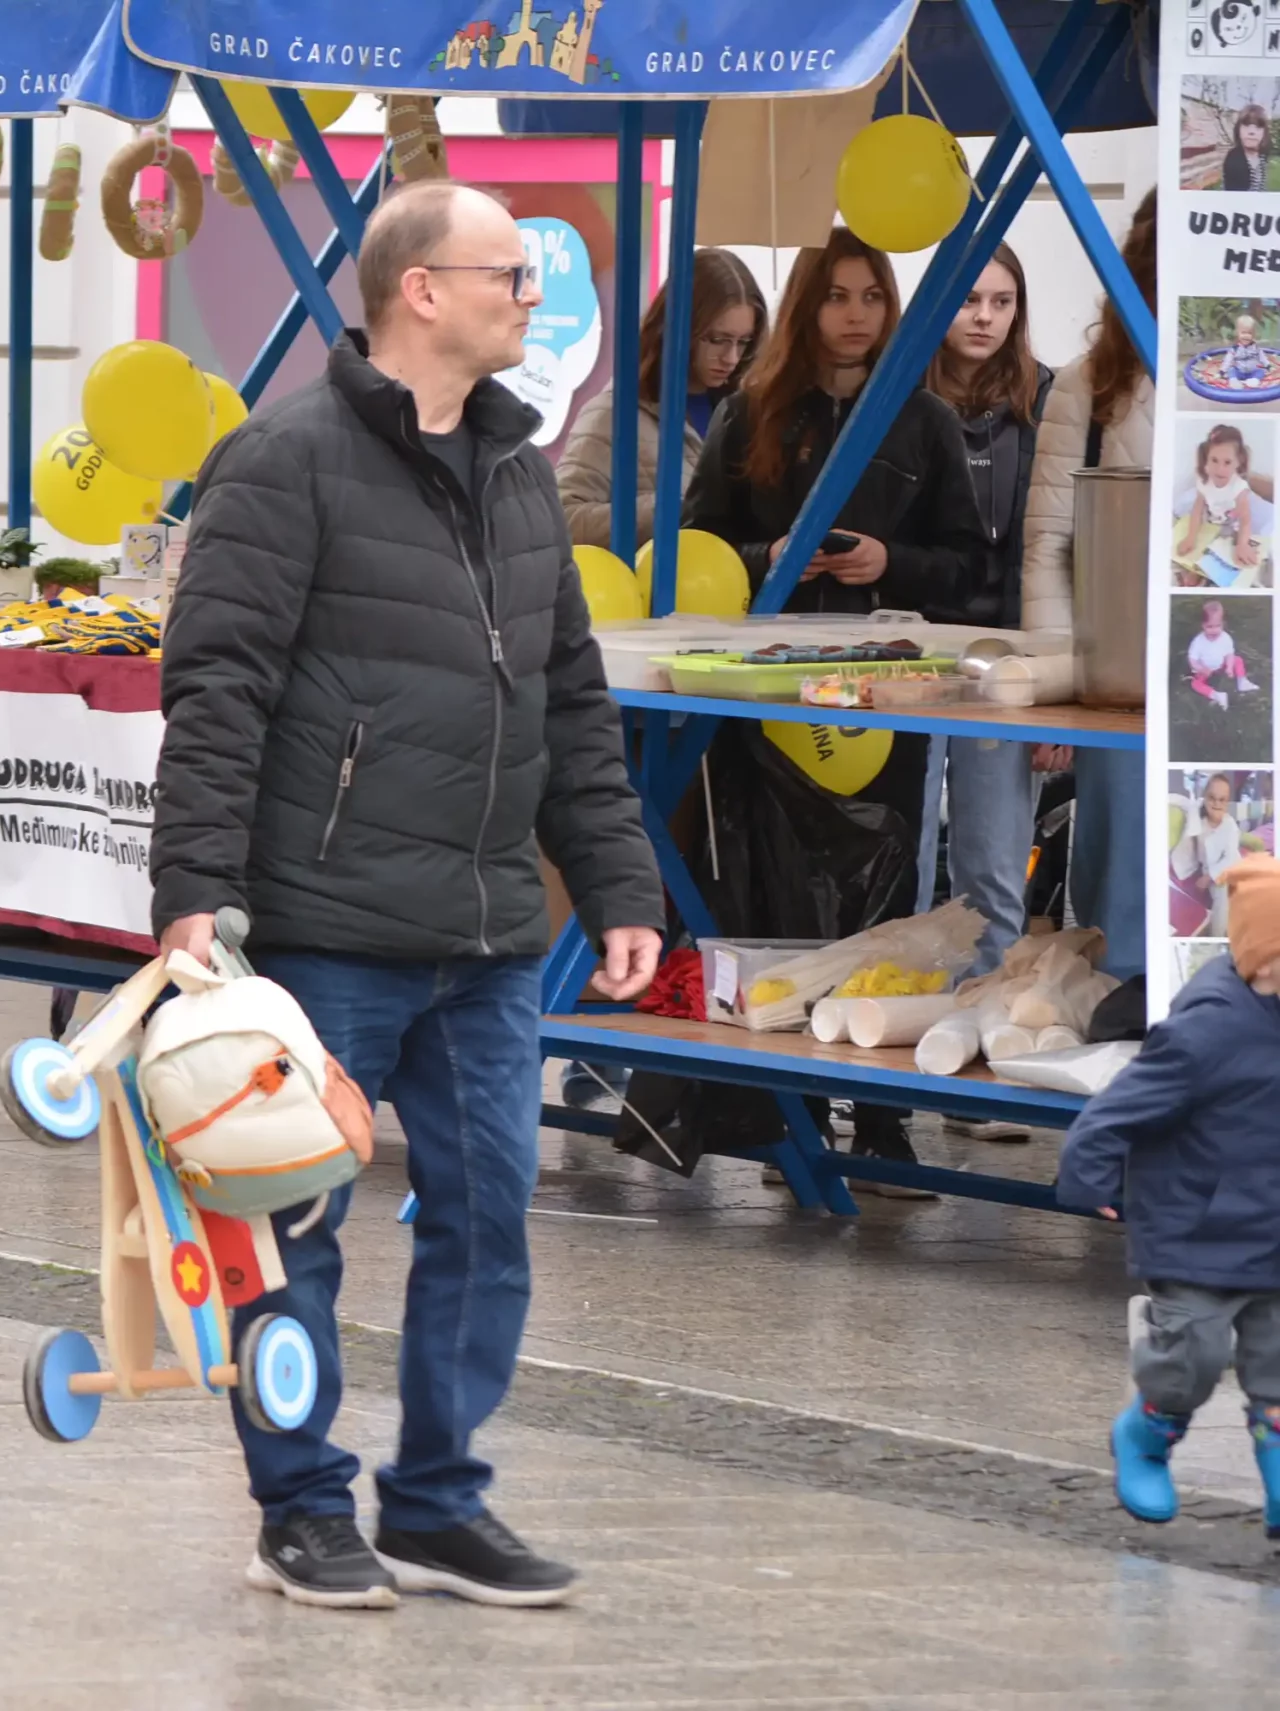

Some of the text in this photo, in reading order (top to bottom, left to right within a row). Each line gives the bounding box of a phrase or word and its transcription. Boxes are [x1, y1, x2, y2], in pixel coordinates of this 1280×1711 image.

[210, 32, 401, 68] GRAD ČAKOVEC
[646, 45, 835, 72] GRAD ČAKOVEC
[1189, 210, 1280, 237] UDRU
[51, 430, 95, 470] 20
